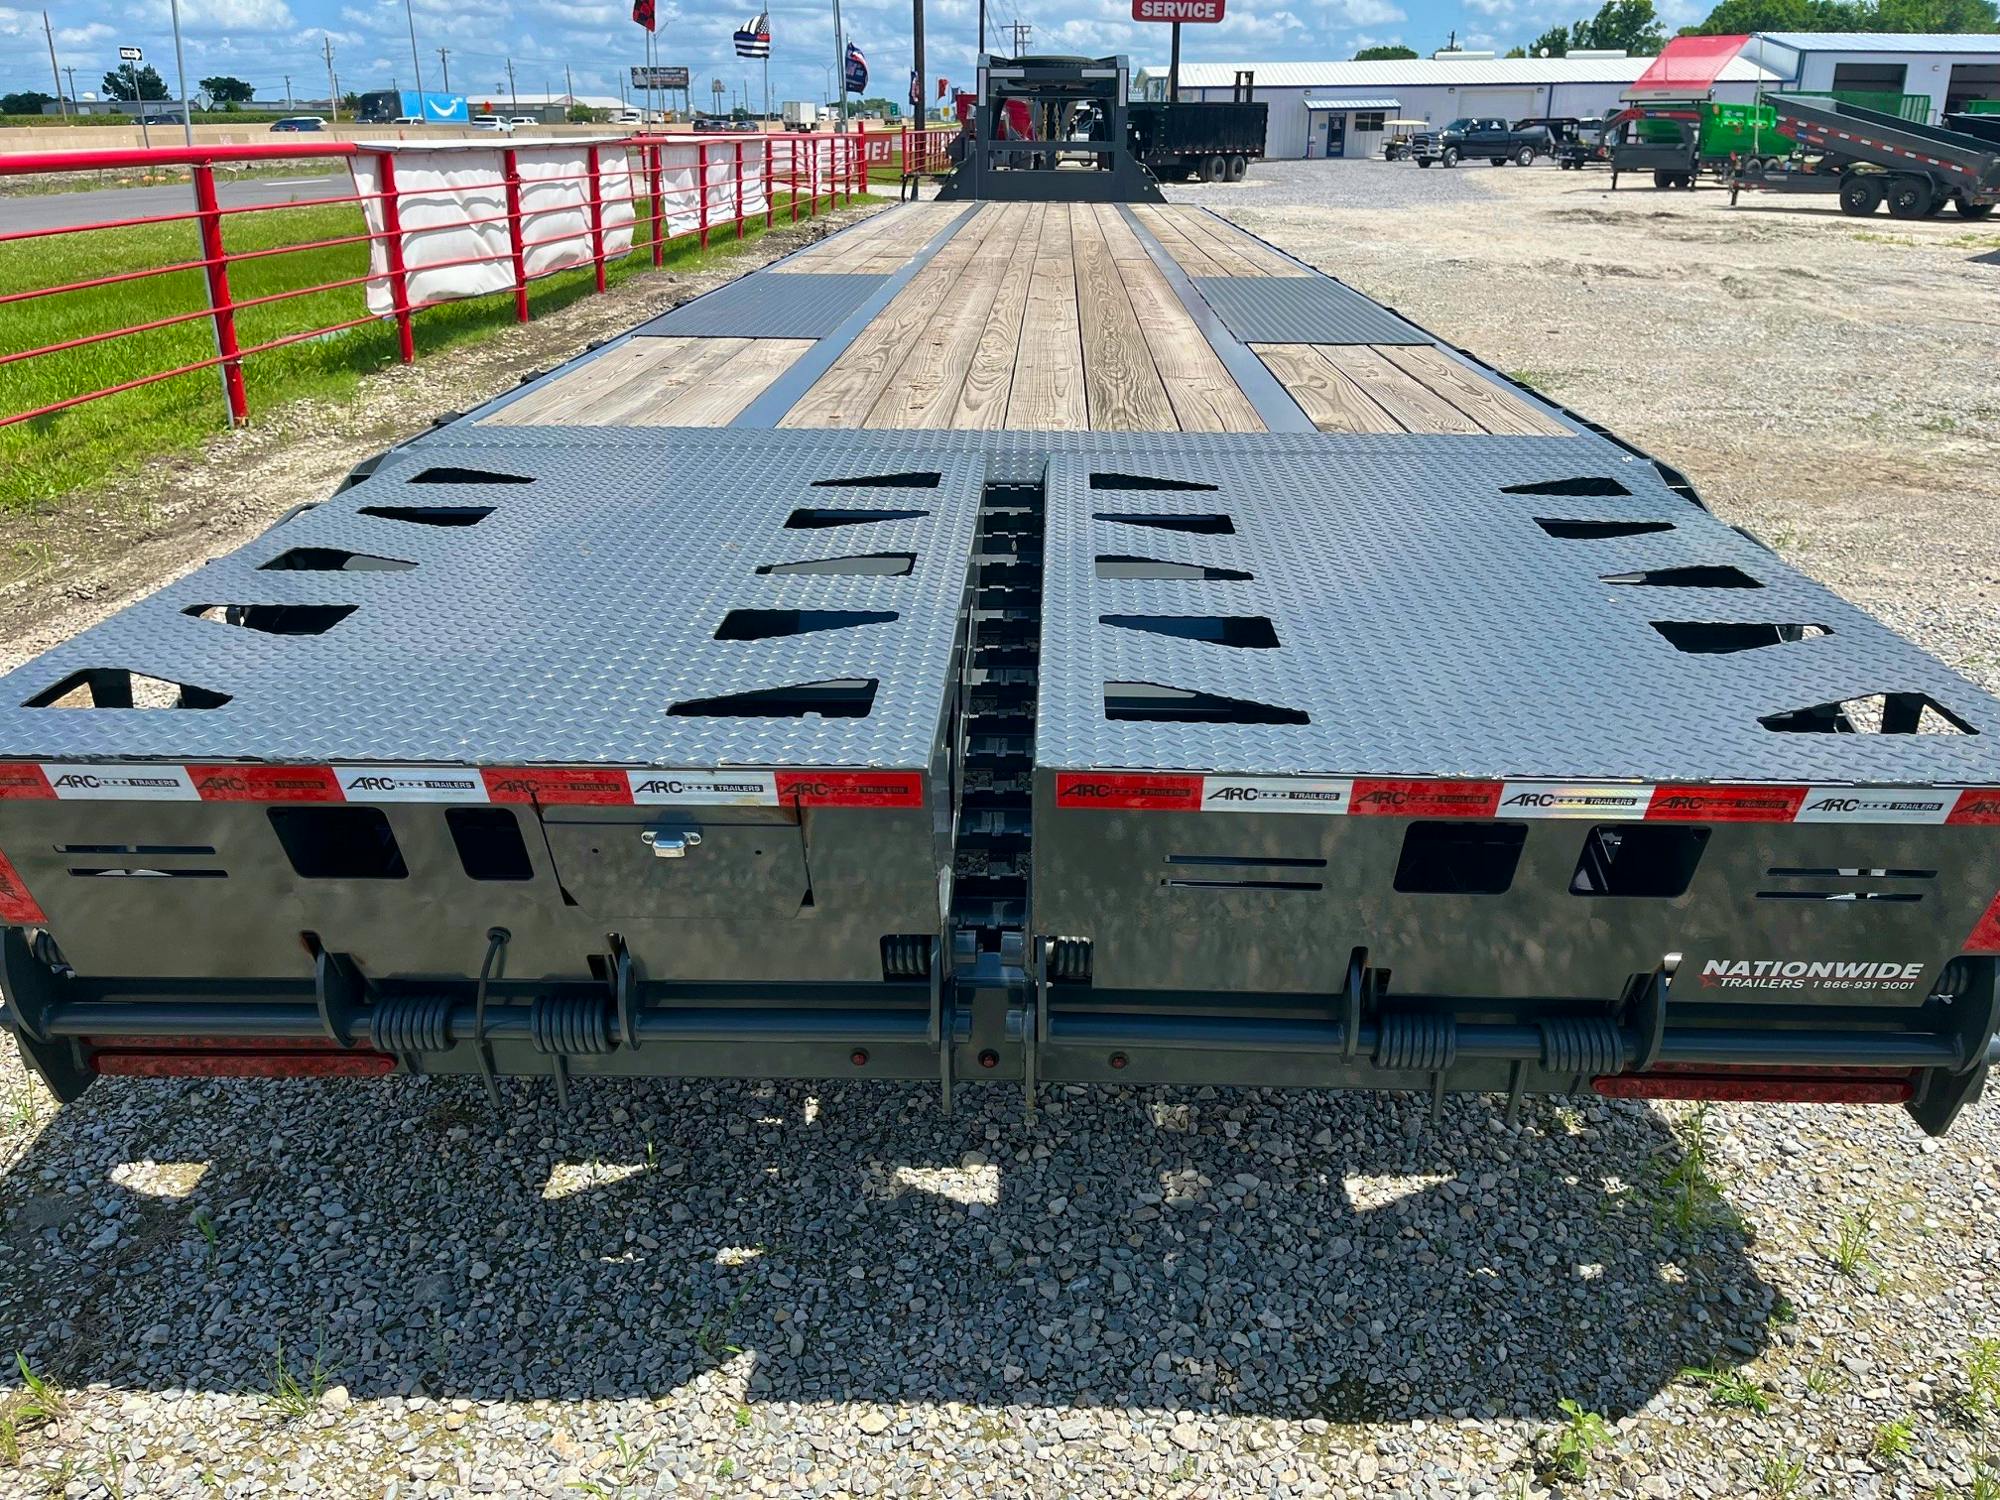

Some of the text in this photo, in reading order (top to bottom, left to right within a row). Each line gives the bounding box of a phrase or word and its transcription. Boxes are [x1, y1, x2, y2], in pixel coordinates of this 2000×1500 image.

[1140, 1, 1216, 18] SERVICE
[53, 775, 177, 788] ARC TRAILERS
[199, 777, 246, 790] ARC
[347, 777, 473, 790] ARC TRAILERS
[494, 780, 540, 793] ARC
[634, 780, 762, 794] ARC TRAILERS
[783, 782, 830, 796] ARC
[1062, 784, 1111, 798] ARC
[1207, 787, 1337, 801] ARC TRAILERS
[1356, 791, 1408, 804] ARC
[1502, 793, 1634, 807] ARC TRAILERS
[1651, 796, 1704, 809] ARC
[1806, 799, 1940, 812] ARC TRAILERS
[1702, 959, 1924, 979] NATIONWIDE
[1720, 977, 1805, 989] TRAILERS
[1823, 980, 1877, 990] 866-931
[1881, 981, 1915, 990] 3001
